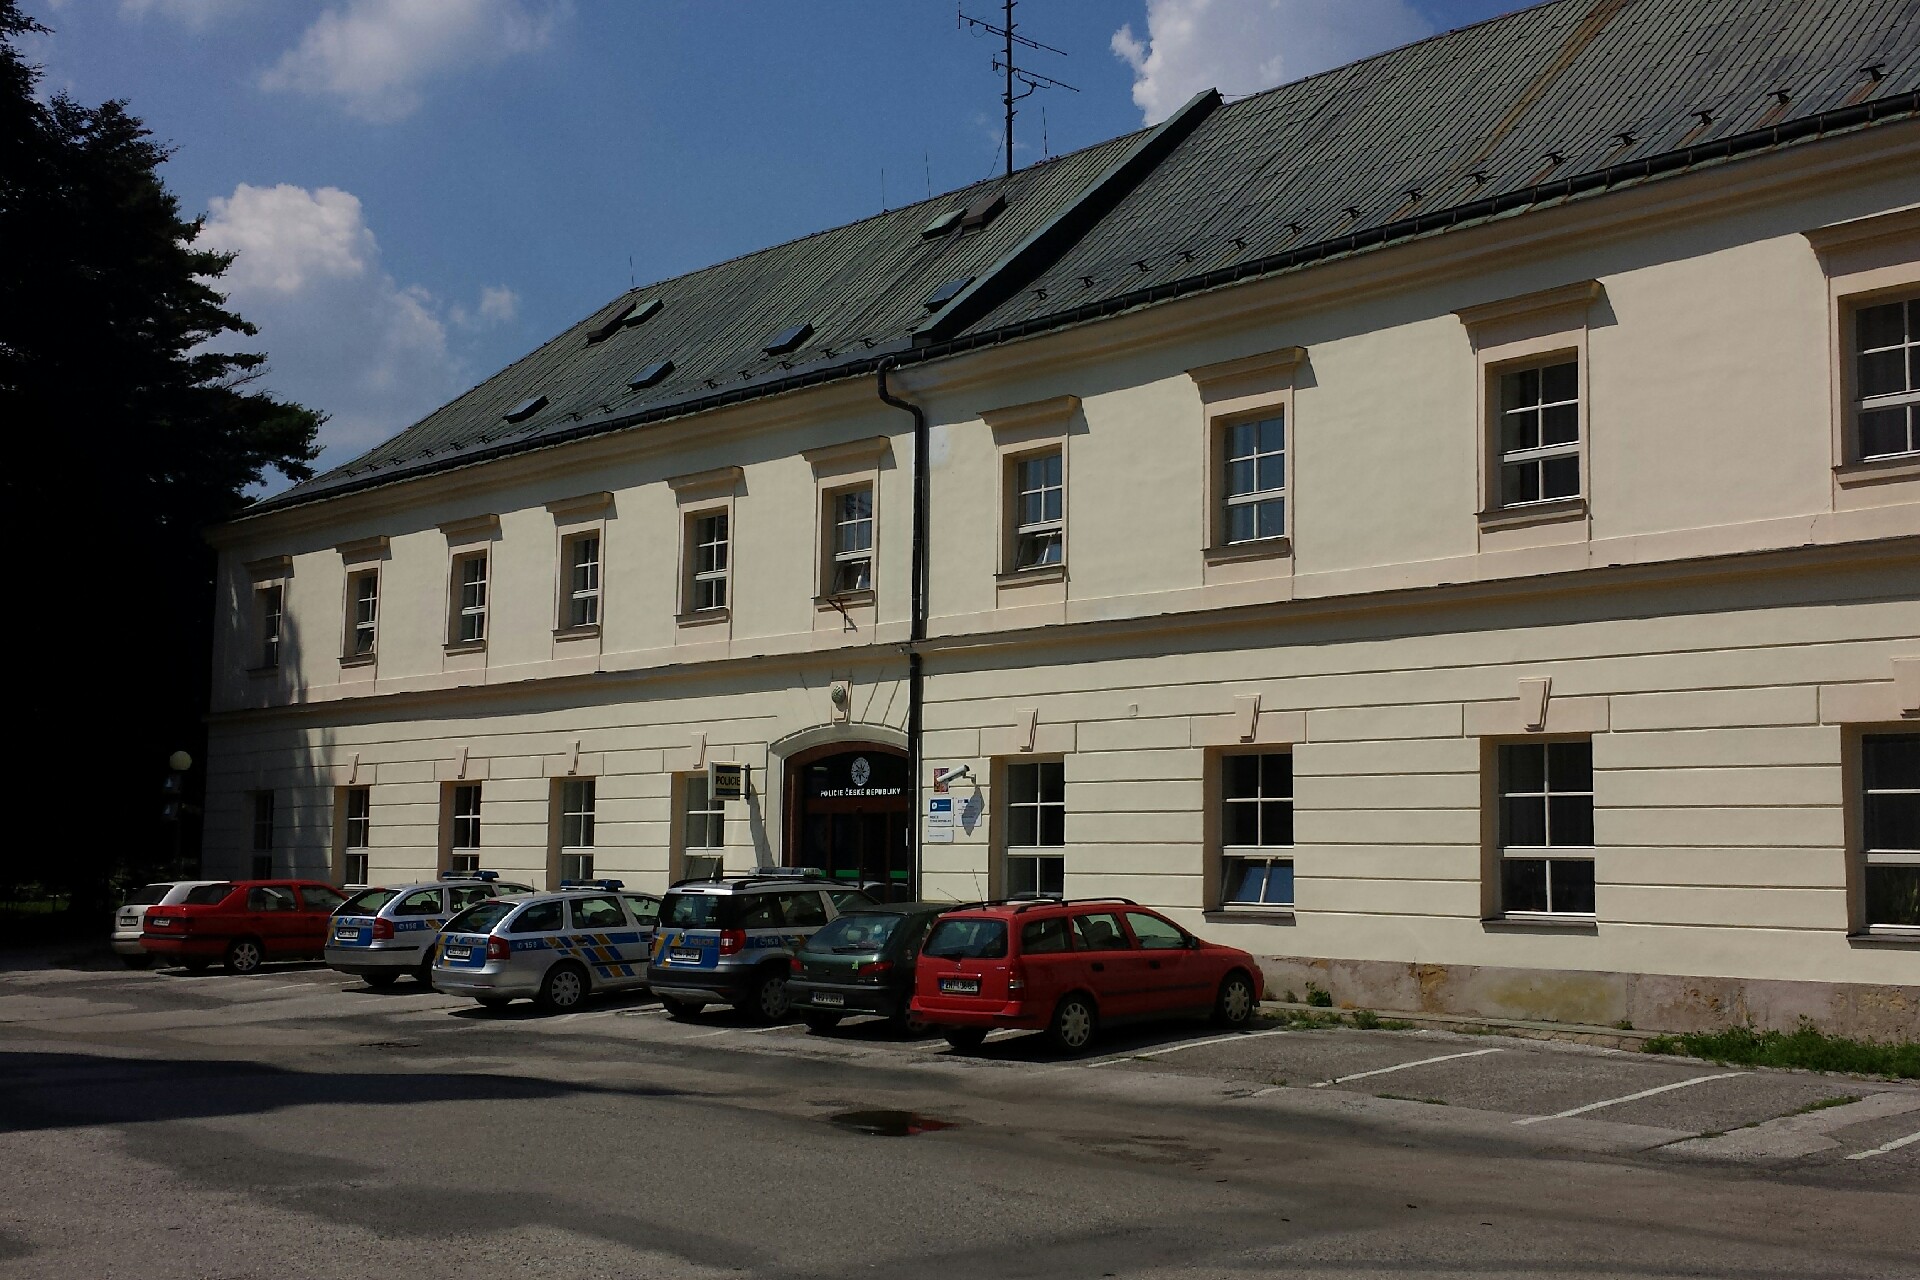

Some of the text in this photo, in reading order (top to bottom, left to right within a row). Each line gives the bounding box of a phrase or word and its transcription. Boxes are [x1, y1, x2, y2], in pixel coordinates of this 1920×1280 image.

[716, 776, 740, 785] POLICIE
[820, 789, 843, 797] POLICIE
[866, 788, 901, 796] REPUBLIKY
